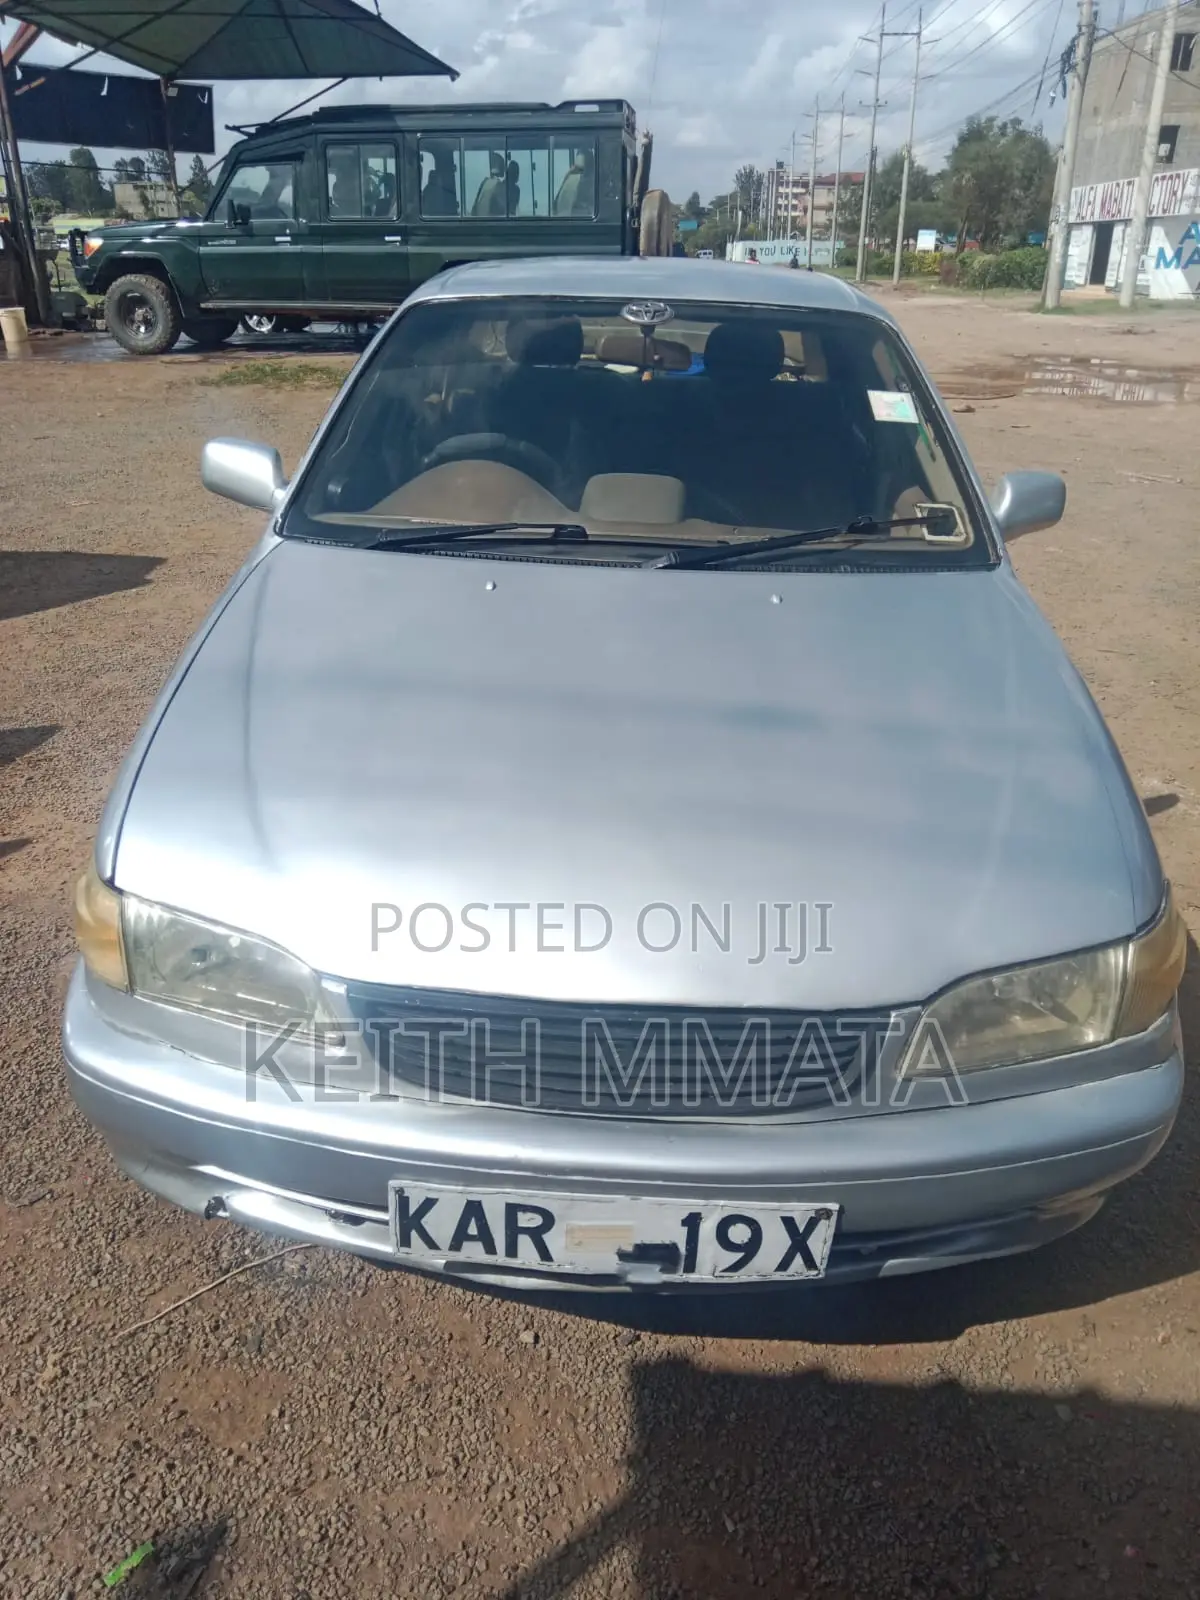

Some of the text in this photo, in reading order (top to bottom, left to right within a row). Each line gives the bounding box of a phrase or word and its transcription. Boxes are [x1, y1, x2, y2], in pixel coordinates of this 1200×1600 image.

[759, 245, 776, 257] YOU
[780, 245, 801, 257] LIKE
[398, 1194, 557, 1263] KAR
